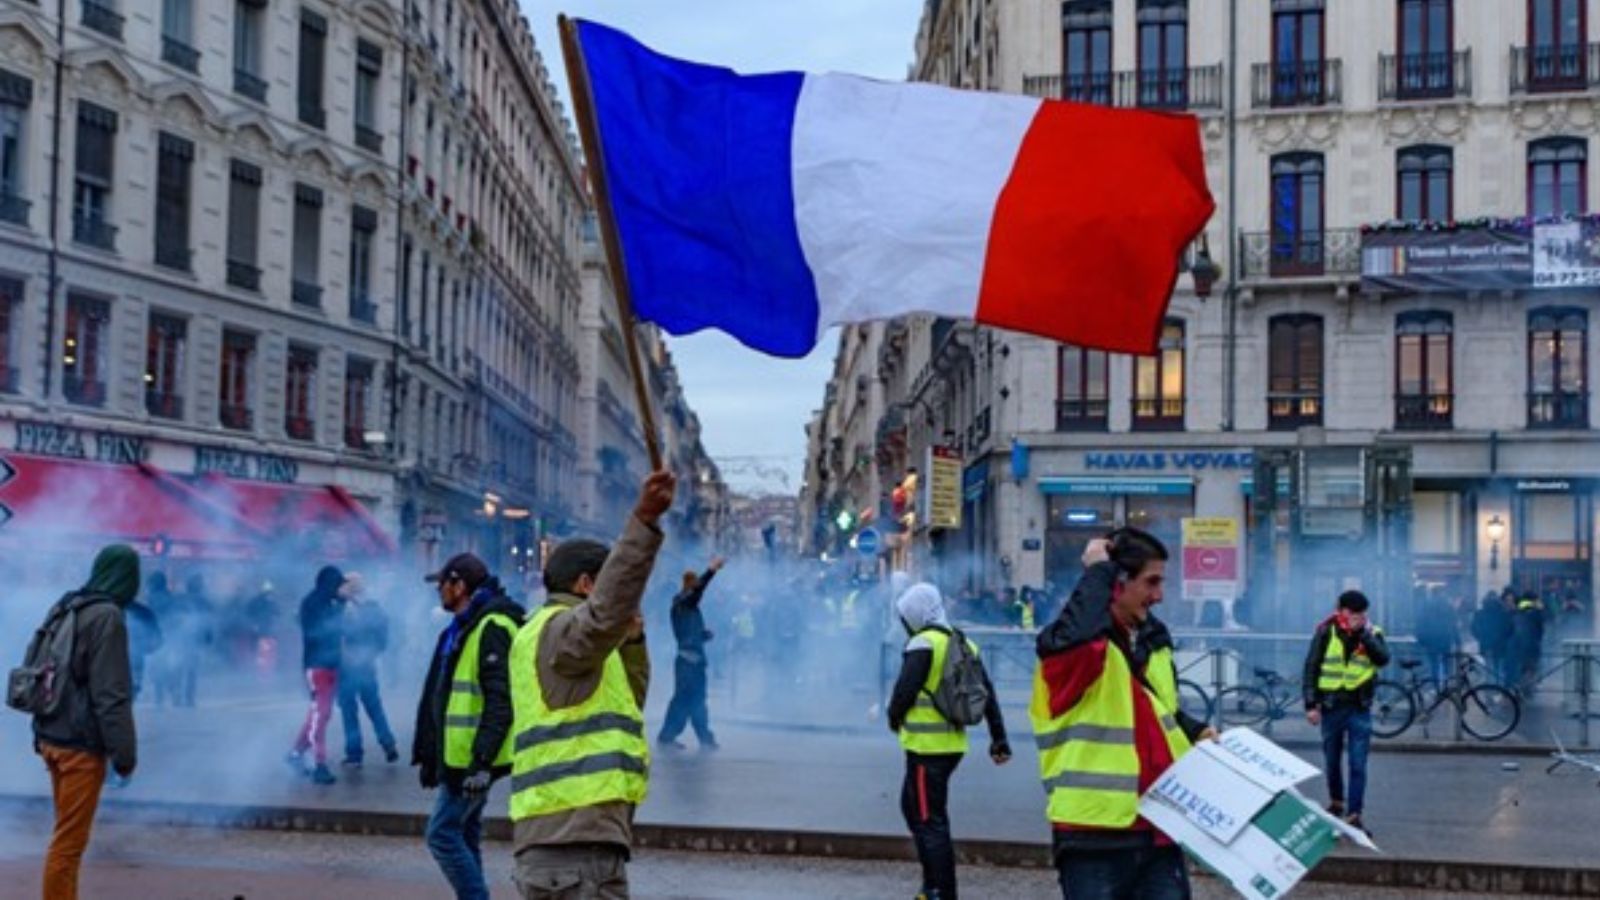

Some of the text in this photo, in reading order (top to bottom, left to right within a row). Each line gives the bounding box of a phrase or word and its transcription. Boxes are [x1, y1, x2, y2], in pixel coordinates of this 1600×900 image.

[16, 423, 85, 457] PIZZA
[1085, 452, 1166, 470] HAVAS
[1158, 773, 1236, 828] image
